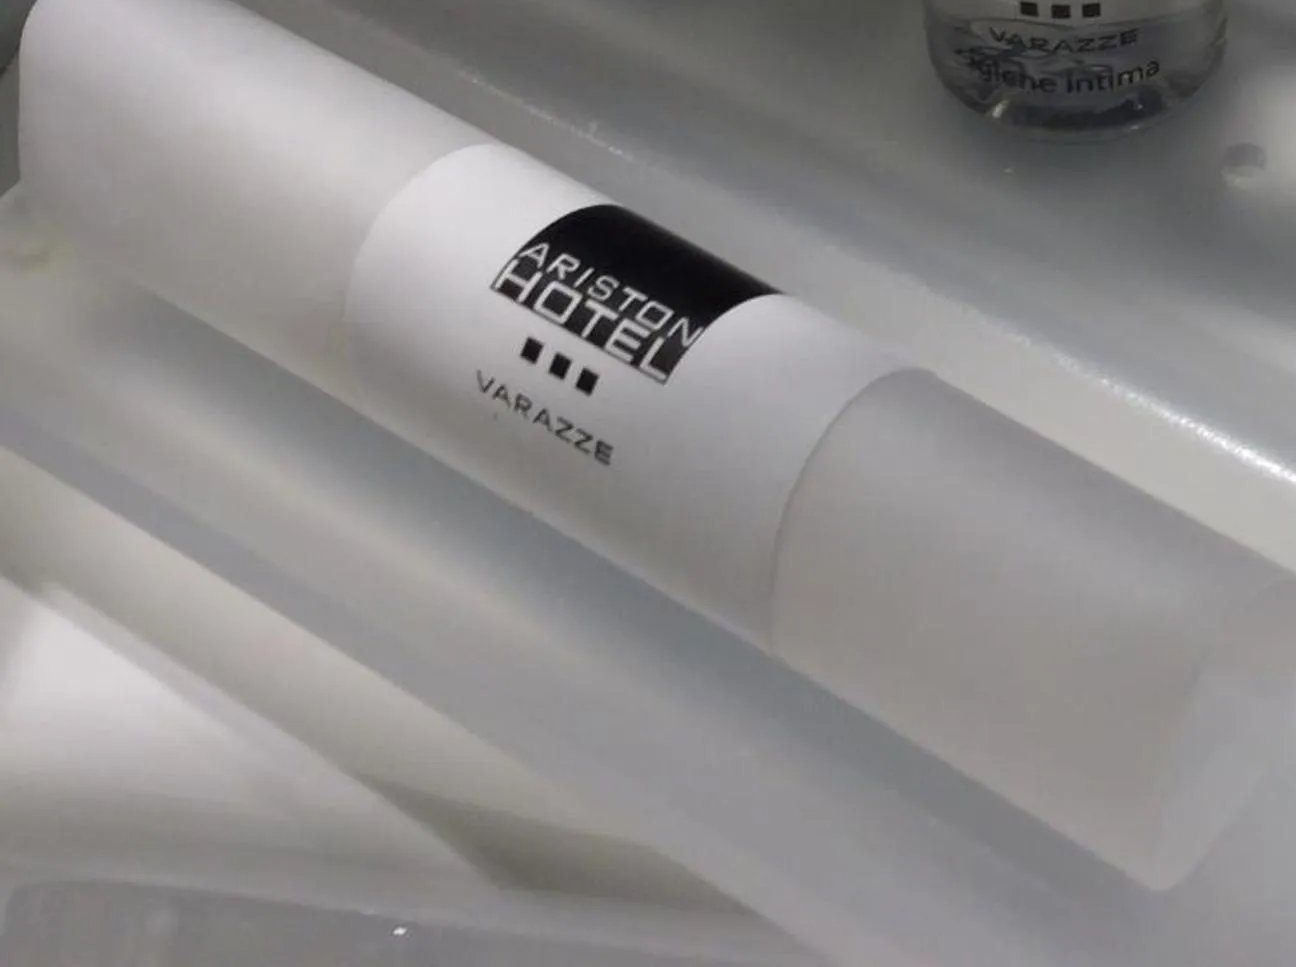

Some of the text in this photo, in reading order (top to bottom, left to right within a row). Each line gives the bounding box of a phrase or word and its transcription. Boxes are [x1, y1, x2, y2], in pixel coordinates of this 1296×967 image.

[989, 26, 1138, 54] VARAZZE
[1064, 58, 1160, 94] intima
[489, 258, 671, 383] HOTEL
[517, 241, 704, 348] ARISTON
[475, 369, 614, 466] VARAZZE
